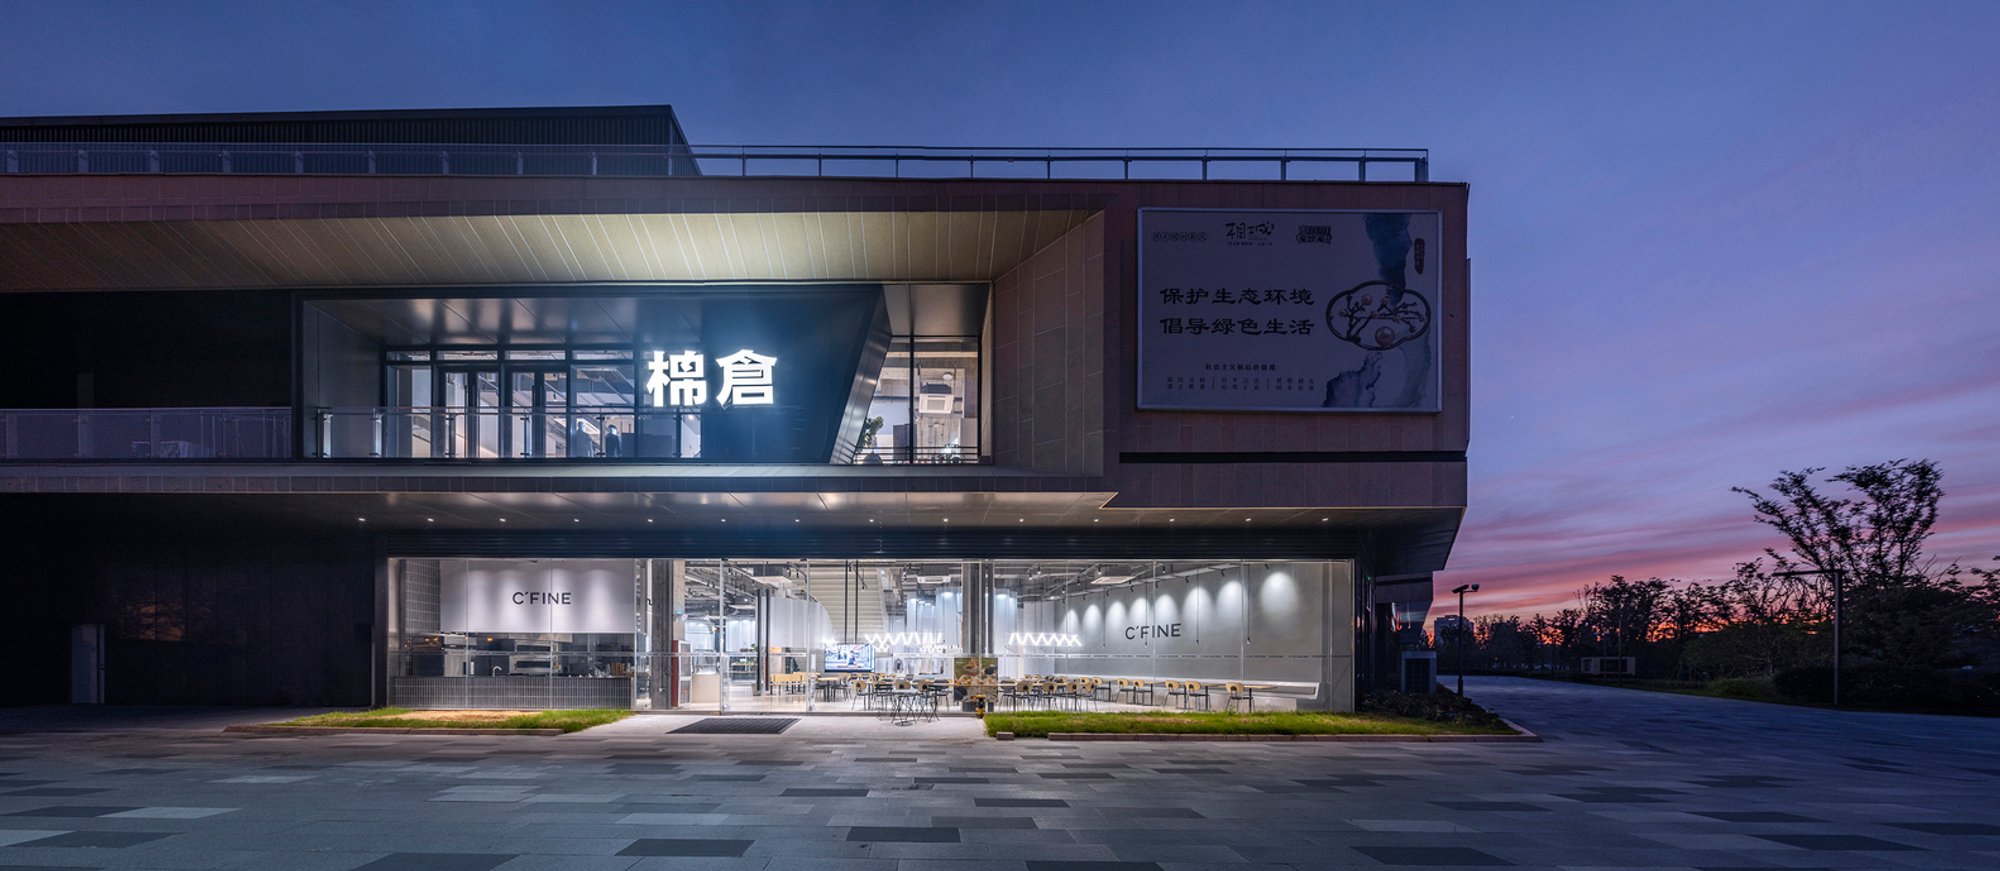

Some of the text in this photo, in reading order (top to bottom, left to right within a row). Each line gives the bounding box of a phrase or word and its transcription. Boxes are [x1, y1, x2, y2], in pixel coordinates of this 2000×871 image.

[1160, 287, 1315, 305] 保护生态环境
[1160, 317, 1315, 336] 倡导绿色生活
[646, 348, 778, 408] 棉倉
